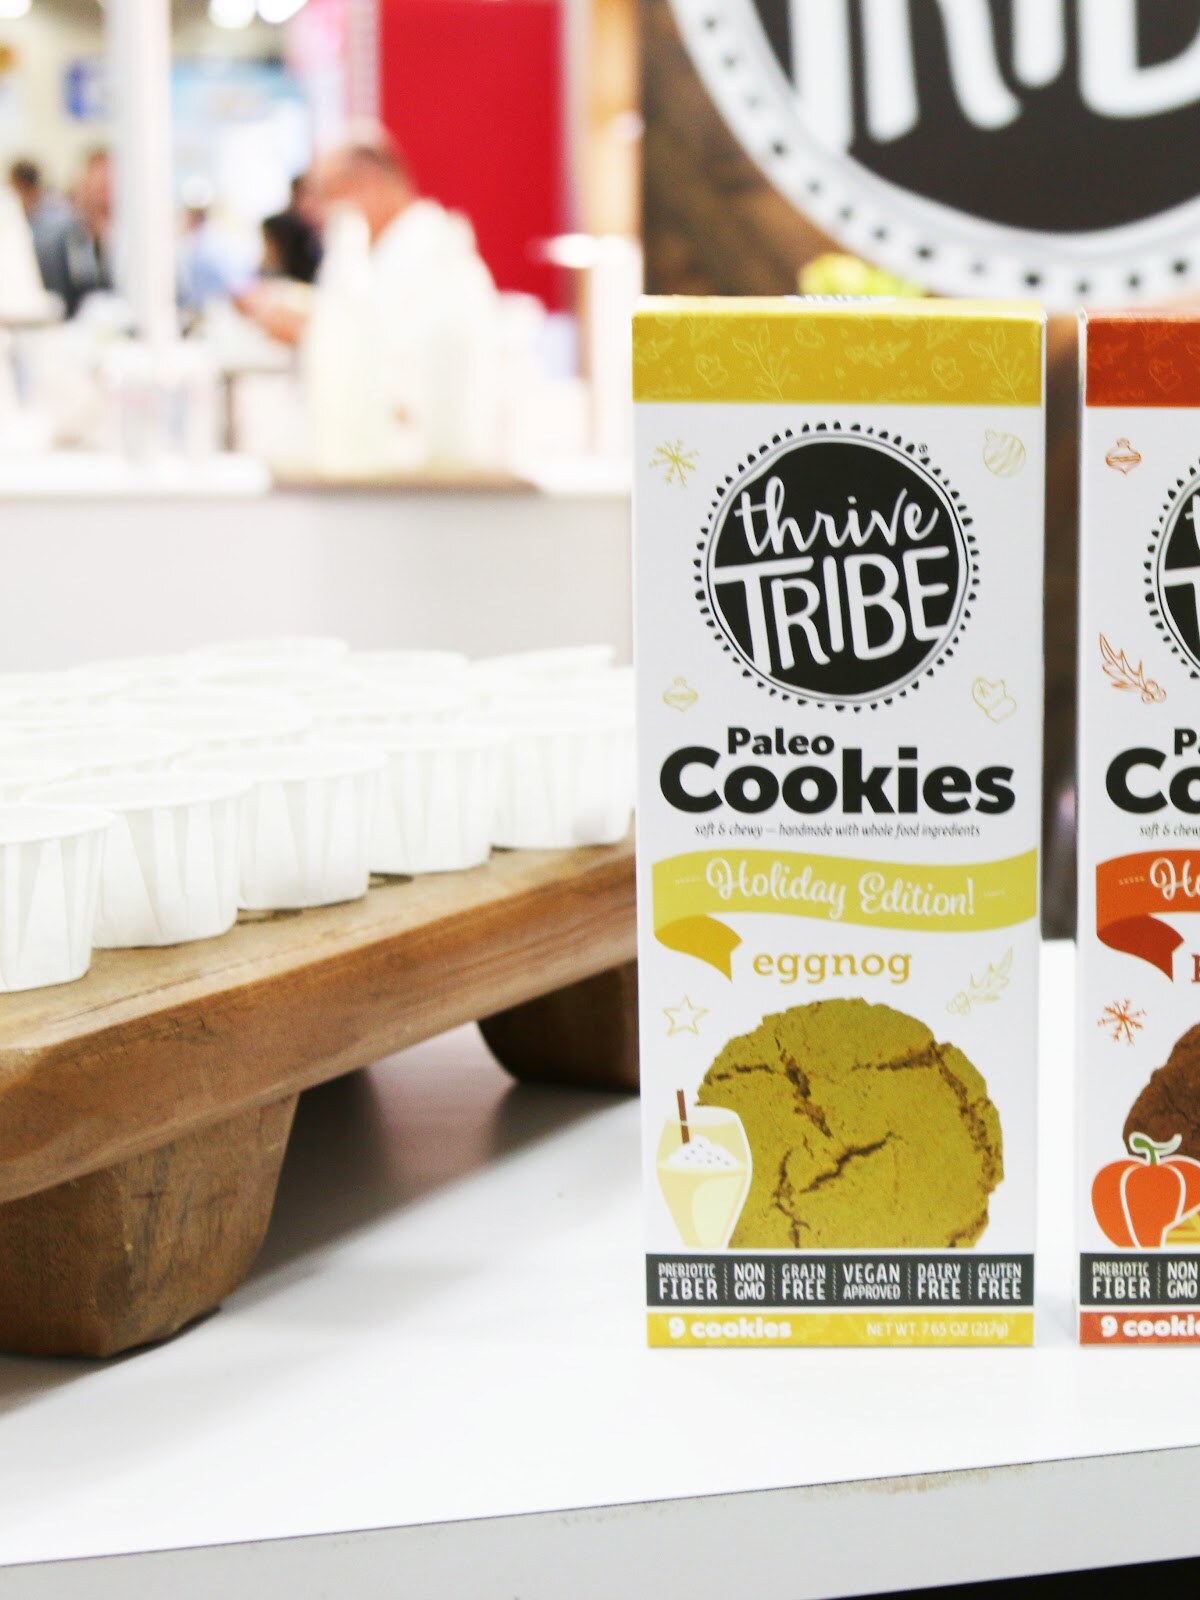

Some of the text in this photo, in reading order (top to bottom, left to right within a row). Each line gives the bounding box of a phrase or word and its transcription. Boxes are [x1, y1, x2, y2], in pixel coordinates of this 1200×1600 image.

[734, 476, 939, 556] thrive
[713, 546, 950, 674] TRIBE
[728, 727, 834, 755] Paleo
[660, 746, 1015, 814] Cookies
[705, 857, 974, 920] Holiday Edition!
[752, 952, 912, 985] eggnog
[658, 1263, 716, 1278] PREBIOTIC
[733, 1263, 765, 1281] NON
[781, 1263, 826, 1280] GRAIN
[842, 1263, 900, 1283] VEGAN
[917, 1263, 962, 1280] DAIRY
[978, 1262, 1022, 1279] GLUTEN
[1092, 1262, 1149, 1276] PREBIOTIC
[1167, 1261, 1198, 1280] NON
[658, 1278, 718, 1300] FIBER
[734, 1281, 765, 1300] GMO
[781, 1279, 826, 1300] FREE
[842, 1284, 900, 1300] APPROVED
[917, 1279, 961, 1300] FREE
[978, 1279, 1021, 1300] FREE
[1092, 1277, 1151, 1299] FIBER
[1167, 1280, 1198, 1299] GMO
[668, 1317, 792, 1338] 9 cookies
[866, 1322, 892, 1337] NET
[949, 1322, 969, 1337] OZ
[1100, 1315, 1117, 1338] 9
